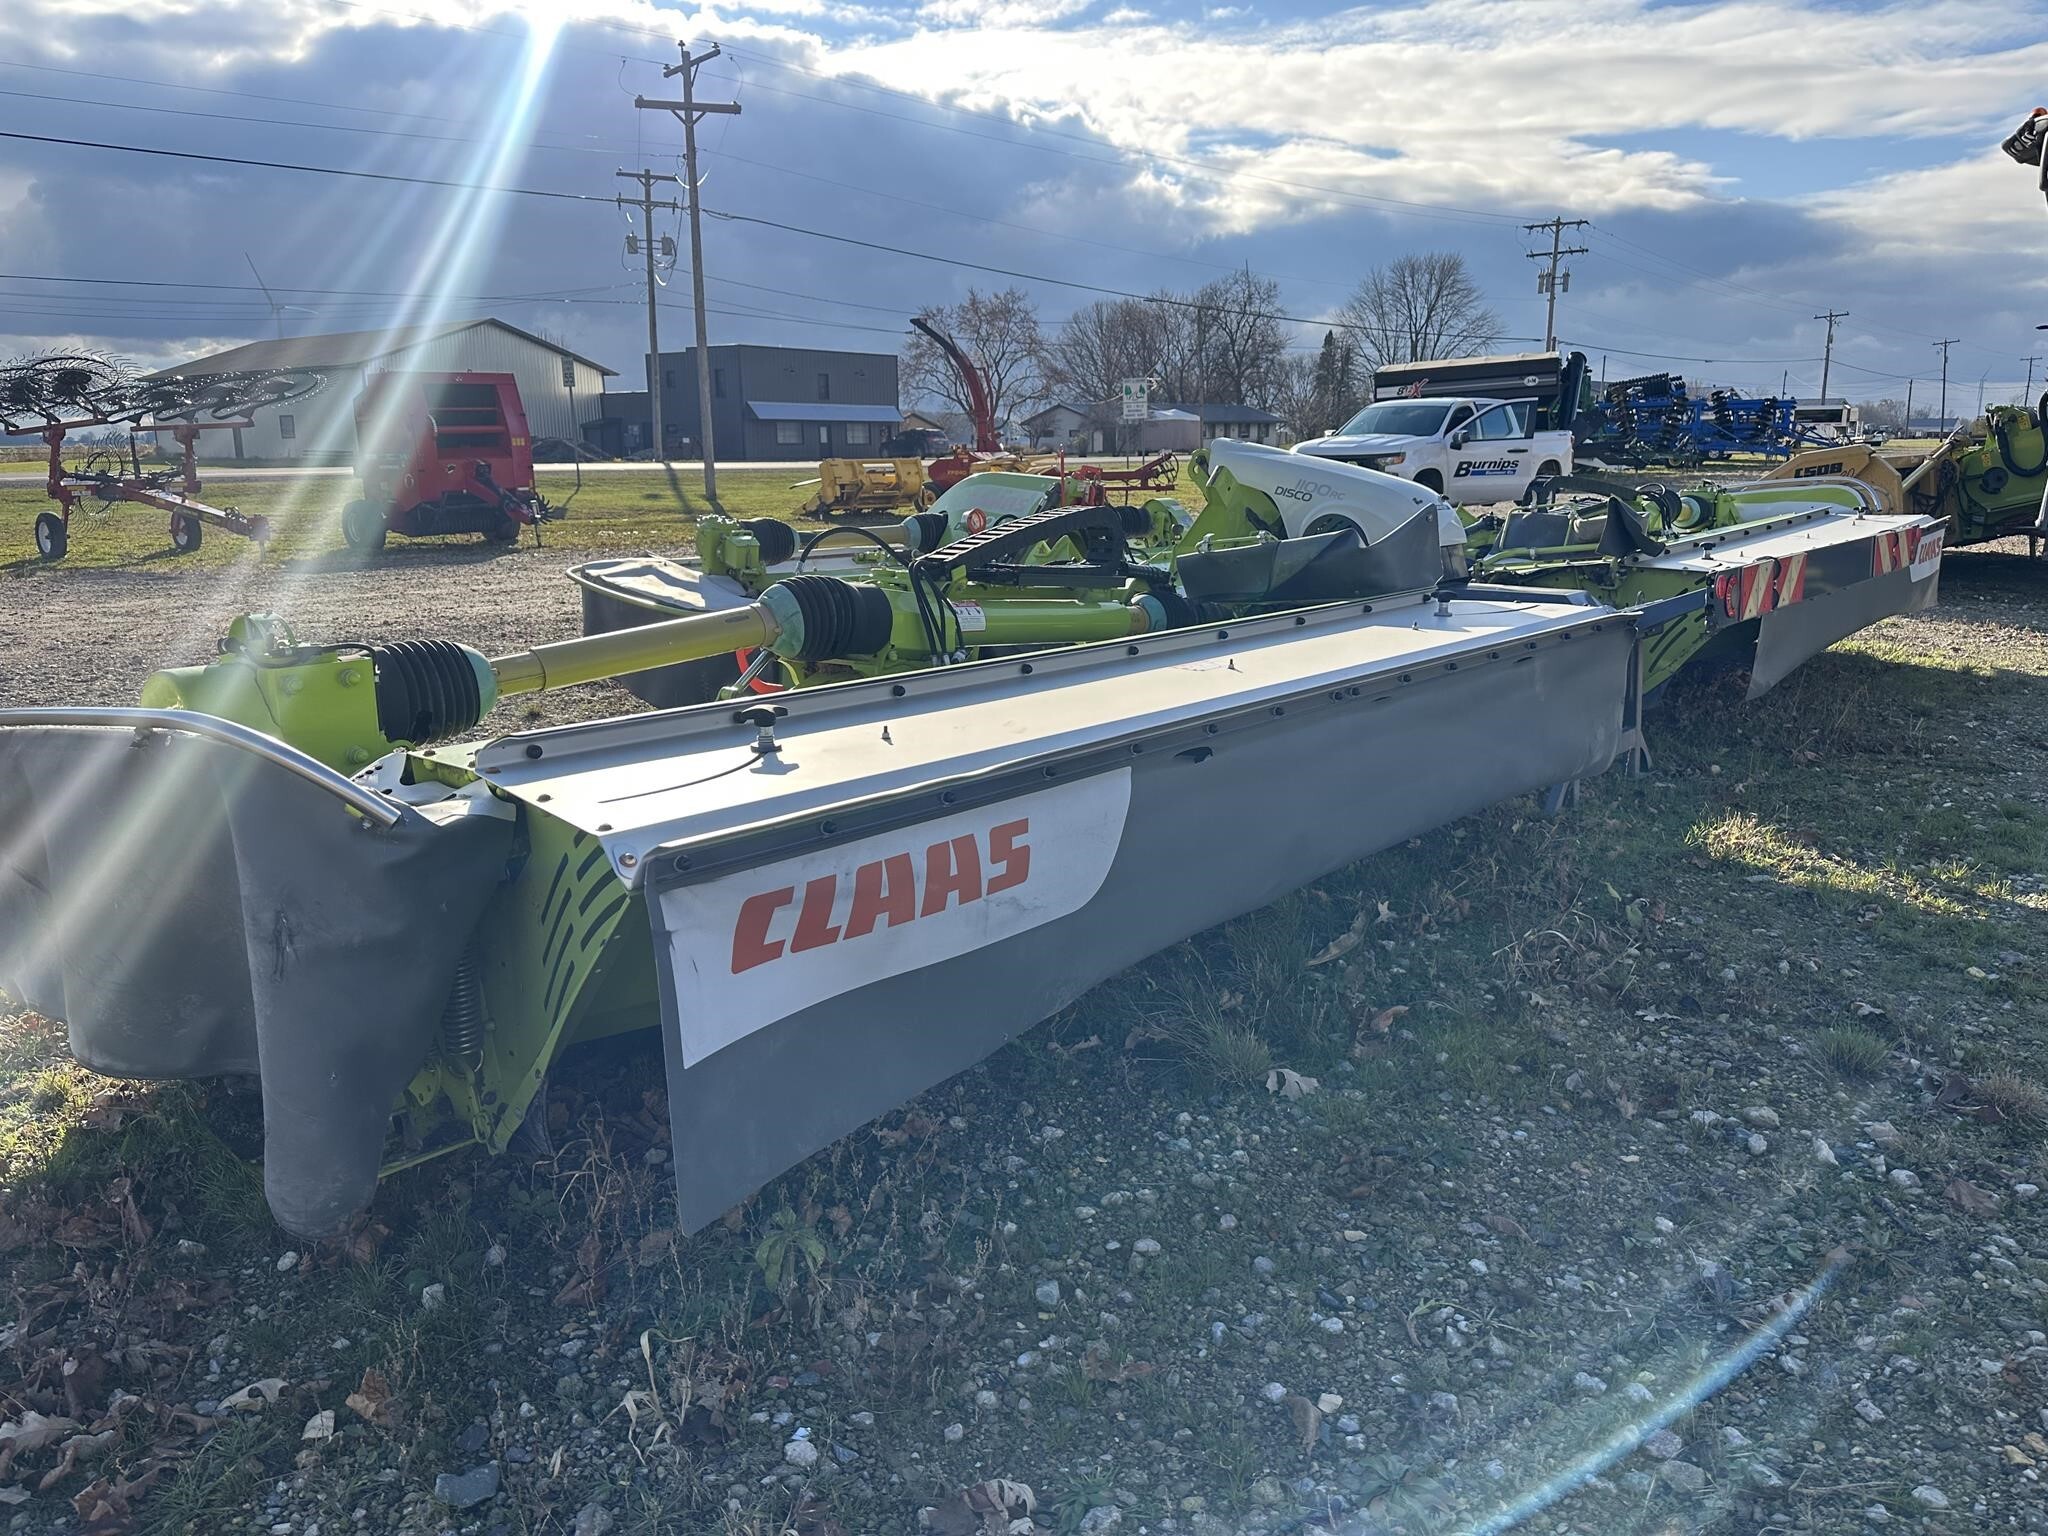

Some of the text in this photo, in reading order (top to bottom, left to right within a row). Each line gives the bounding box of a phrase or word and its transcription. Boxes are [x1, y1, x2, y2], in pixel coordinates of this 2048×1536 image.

[1453, 457, 1520, 478] Burnips
[1274, 486, 1313, 502] DISCO
[1919, 535, 1943, 565] CLAAS
[730, 816, 1031, 975] CLAAS
